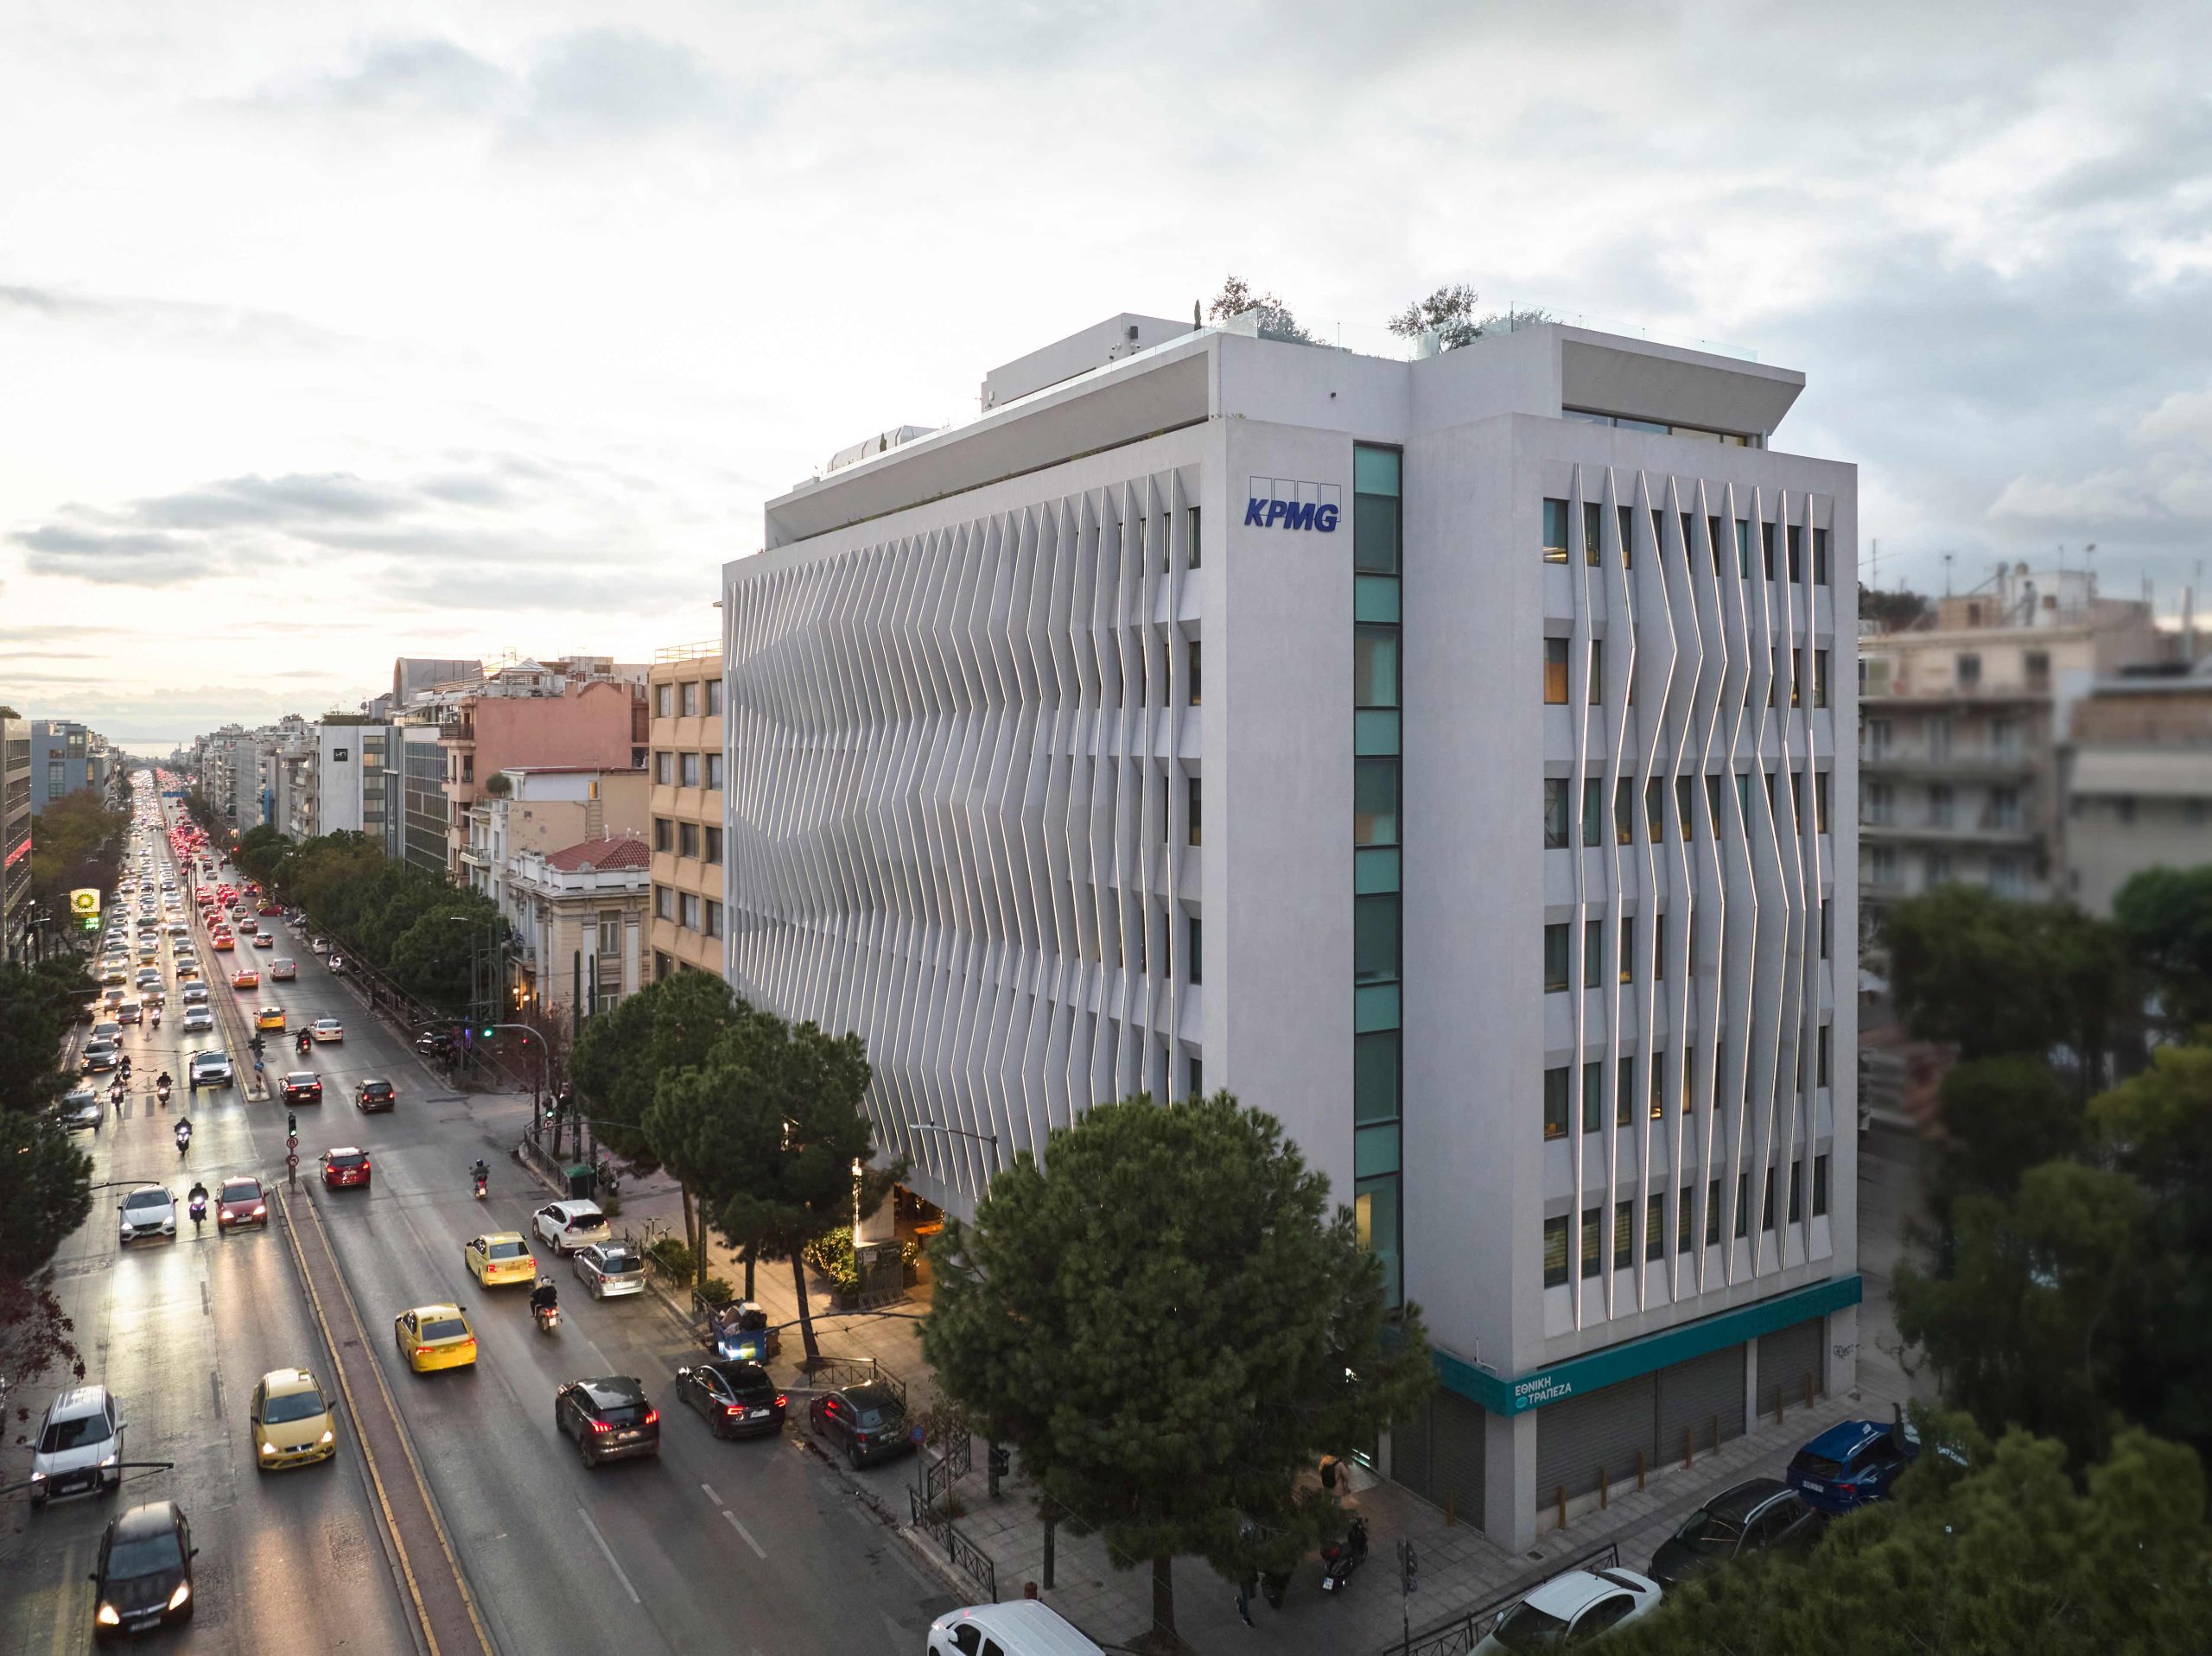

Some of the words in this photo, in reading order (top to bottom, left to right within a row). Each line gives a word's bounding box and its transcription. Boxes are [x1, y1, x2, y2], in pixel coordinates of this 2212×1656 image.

[1244, 498, 1338, 532] KPMG
[1515, 1376, 1551, 1396] ΕΘΝΙΚΗ
[1528, 1382, 1572, 1405] ΤΡΑΠΕΖΑ
